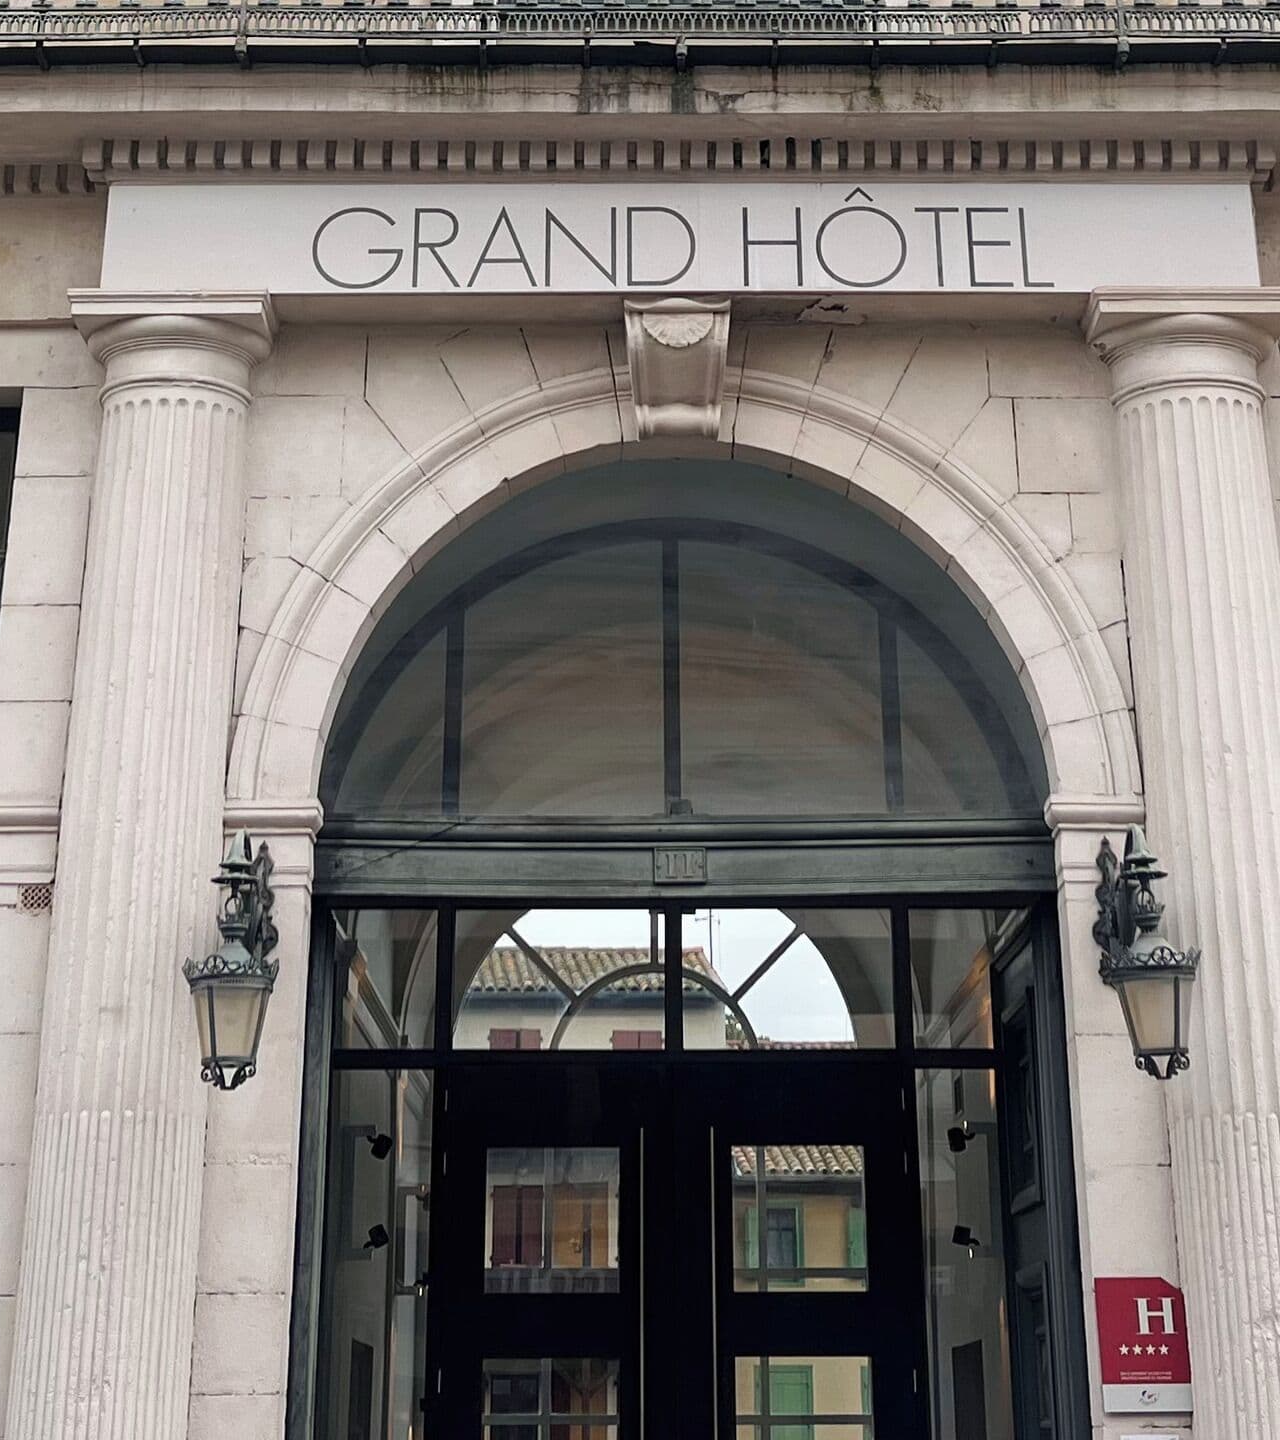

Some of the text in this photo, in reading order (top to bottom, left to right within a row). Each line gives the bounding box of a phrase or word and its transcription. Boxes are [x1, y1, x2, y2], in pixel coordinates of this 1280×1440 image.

[312, 187, 1055, 290] GRAND HÔTEL
[1133, 1296, 1178, 1335] H
